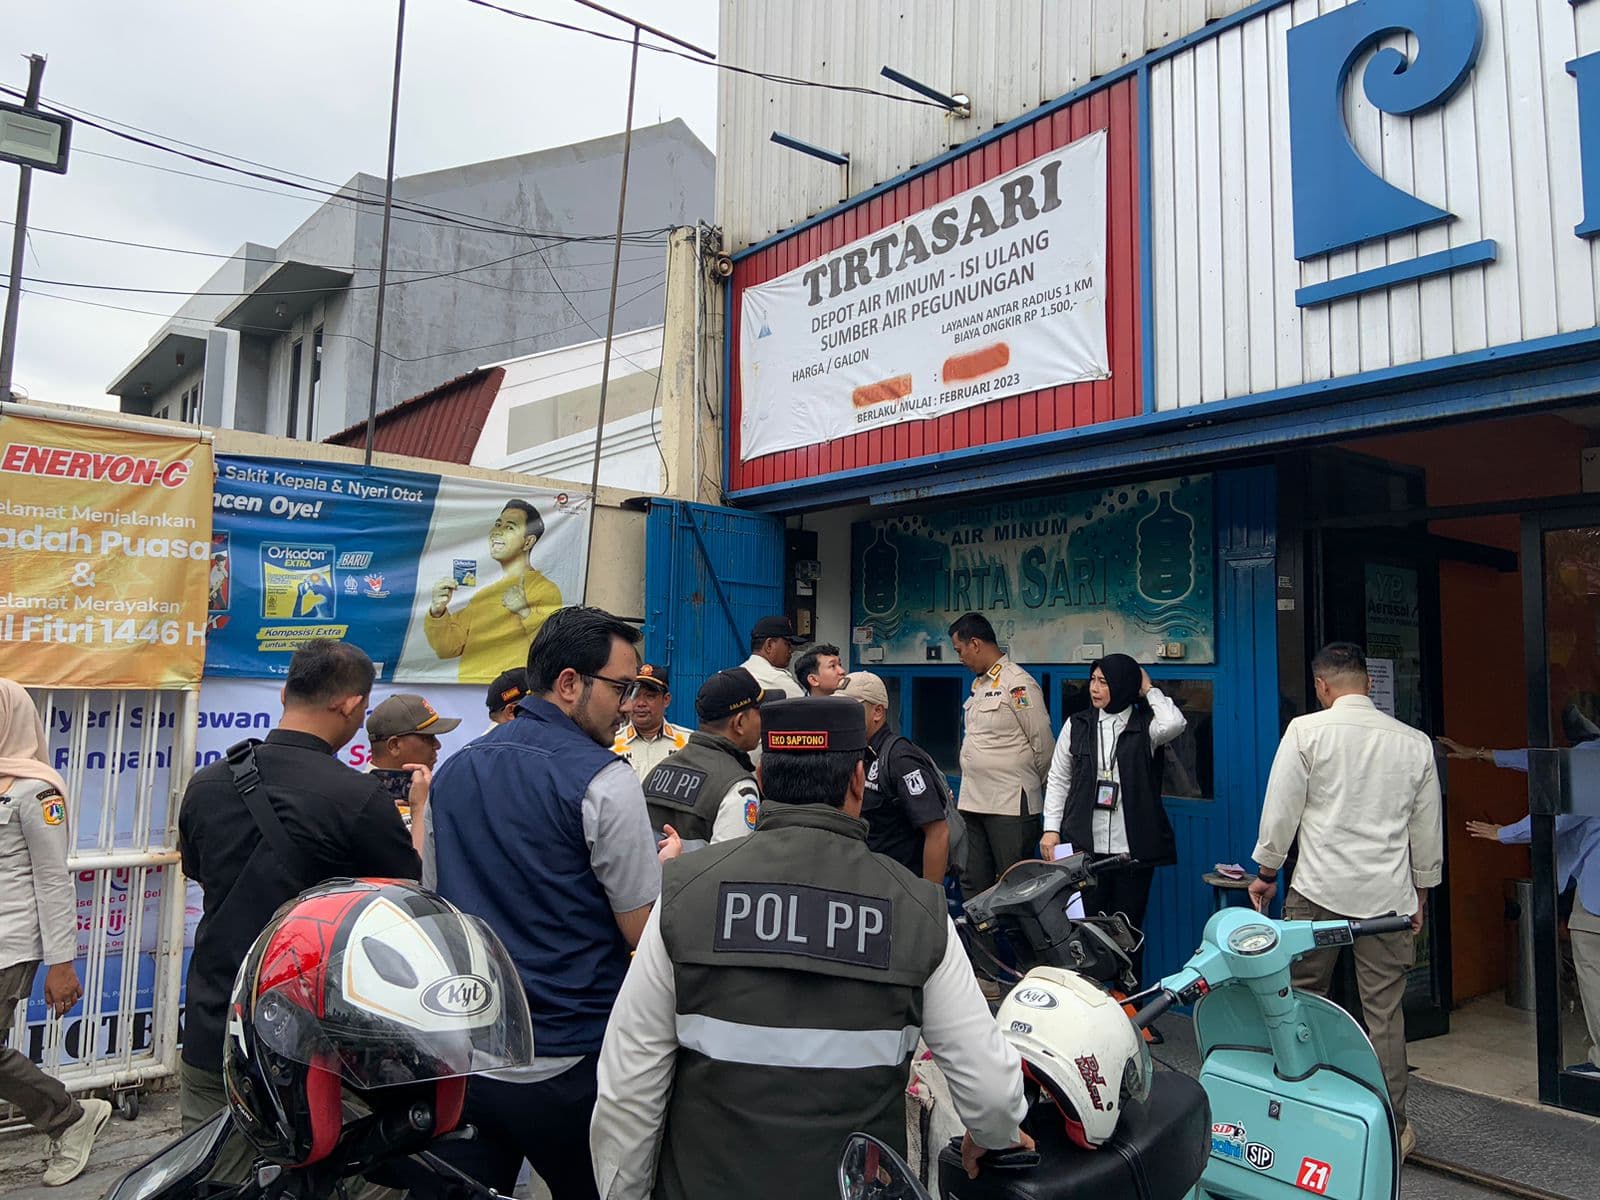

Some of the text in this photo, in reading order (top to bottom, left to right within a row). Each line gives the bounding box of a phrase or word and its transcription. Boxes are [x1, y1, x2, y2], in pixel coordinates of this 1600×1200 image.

[803, 160, 1062, 306] TIRTASARI
[811, 304, 855, 333] DEPOT
[857, 295, 882, 317] AIR
[886, 269, 946, 307] MINUM
[960, 254, 980, 279] ISI
[985, 229, 1050, 270] ULANG
[820, 263, 1035, 352] SUMBER AIR PEGUNUNGAN
[941, 276, 1093, 335] LAYANAN ANTAR RADIUS 1 KM
[953, 300, 1078, 344] BIAYA ONGKIR RP 1.500,-
[792, 363, 825, 383] HARGA
[833, 348, 870, 370] GALON
[856, 404, 897, 424] BERLAKU
[899, 396, 932, 413] MULAI
[939, 380, 991, 406] FEBRUARI
[993, 373, 1021, 389] 2023
[1, 444, 192, 489] ENERVON-C
[225, 465, 269, 484] Sakit
[273, 471, 328, 492] Kepala
[331, 479, 344, 494] &
[348, 481, 388, 500] Nyeri
[392, 487, 424, 503] Otot
[72, 505, 196, 529] Menjalankan
[268, 495, 324, 521] Oye!
[101, 530, 211, 560] Puasa
[951, 518, 1069, 546] AIR MINUM
[267, 546, 327, 562] Oskadon
[284, 559, 312, 568] EXTRA
[340, 553, 370, 568] BARU
[71, 562, 96, 588] &
[920, 544, 1108, 613] TIRTA SARI
[74, 595, 180, 615] Merayakan
[22, 613, 93, 644] Fitri
[101, 618, 180, 645] 1446
[186, 622, 207, 646] H
[264, 627, 343, 638] Komposisi Extra
[771, 735, 824, 745] EKO SAPTONO
[648, 768, 701, 798] POL PP
[722, 891, 884, 954] POL PP
[1012, 1021, 1031, 1033] DOT
[1249, 1145, 1271, 1167] SIP
[1301, 1160, 1329, 1190] 7.1
